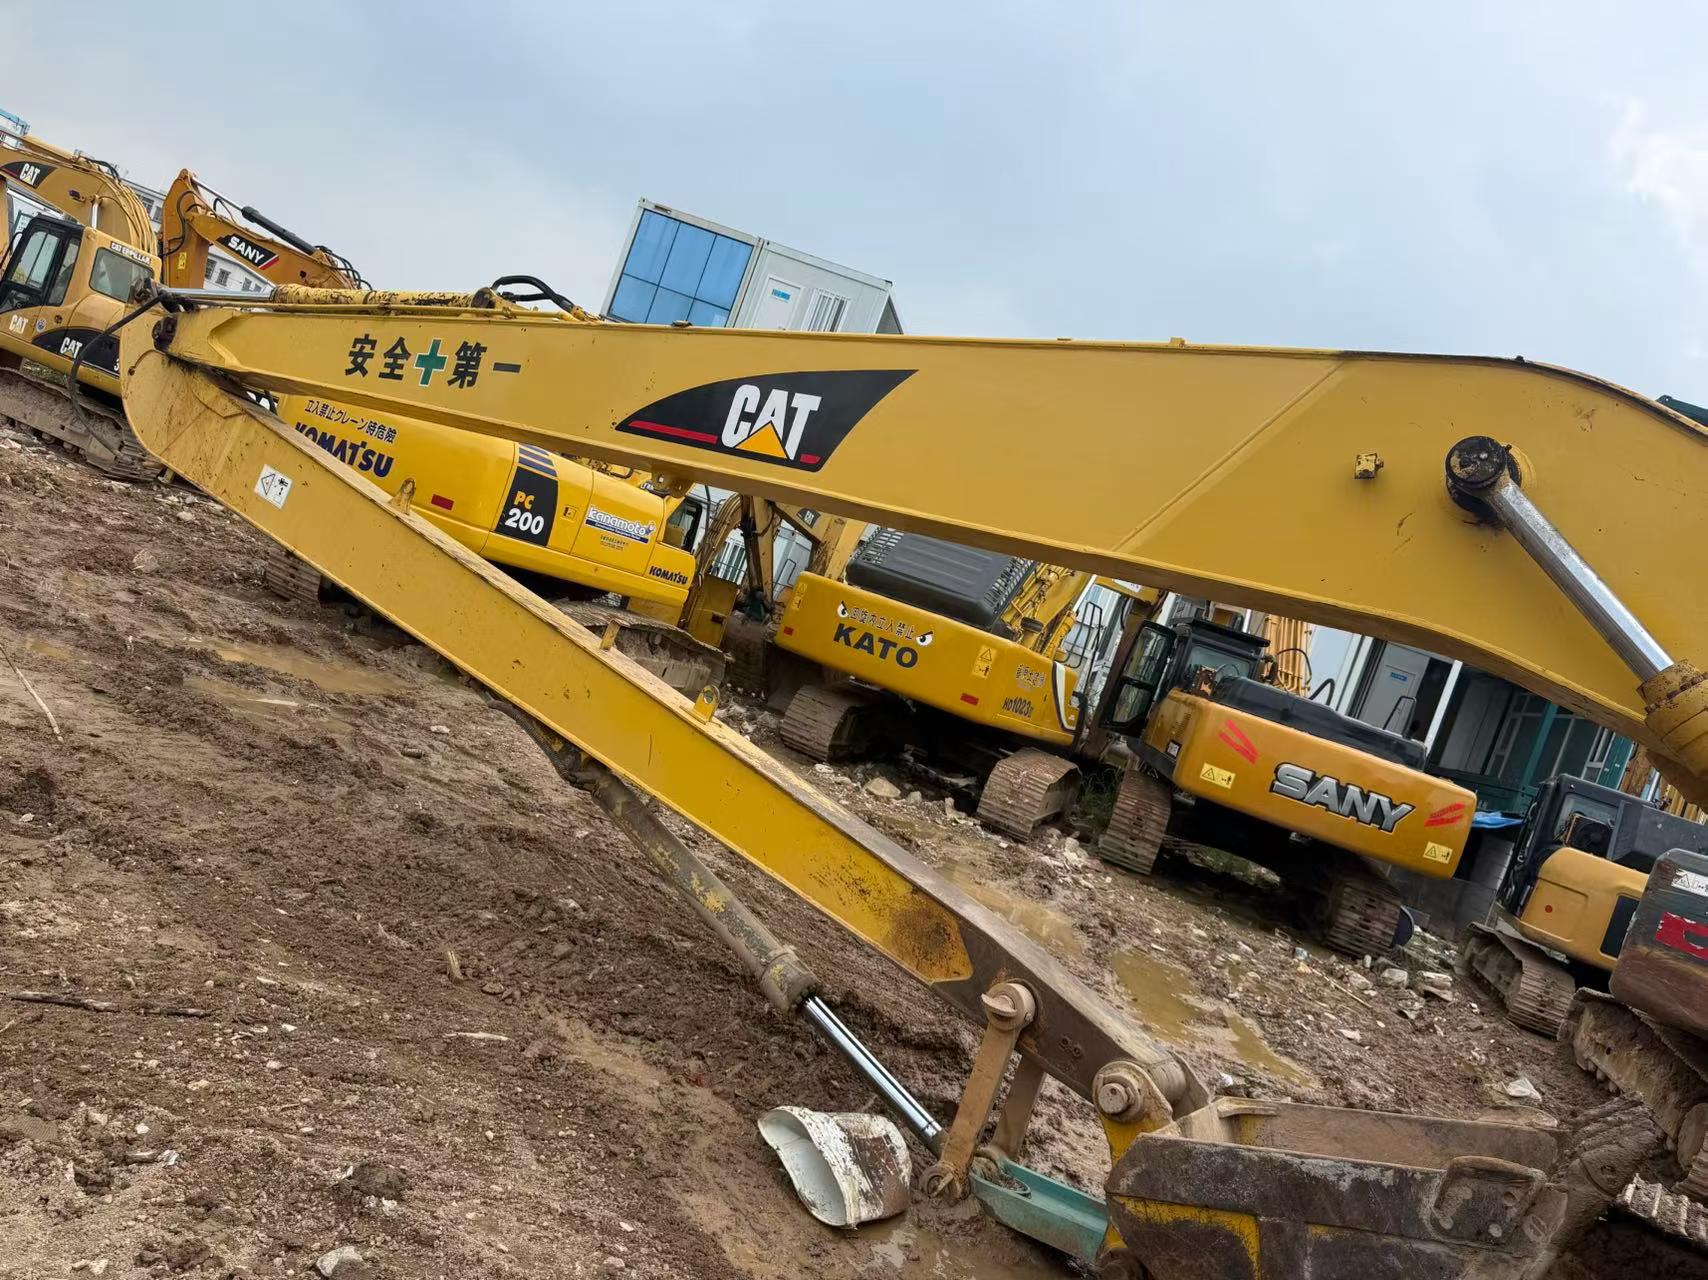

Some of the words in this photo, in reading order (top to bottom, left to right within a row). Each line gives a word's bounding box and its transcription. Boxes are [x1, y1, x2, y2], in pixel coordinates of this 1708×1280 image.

[19, 163, 41, 186] CAT
[227, 236, 264, 264] SANY
[9, 314, 29, 334] CAT
[60, 337, 83, 359] CAT
[721, 384, 822, 460] CAT
[513, 490, 535, 510] PC
[504, 507, 545, 535] 200
[649, 565, 688, 585] KOMATSU
[833, 622, 919, 668] KATO
[1270, 762, 1416, 834] SANY
